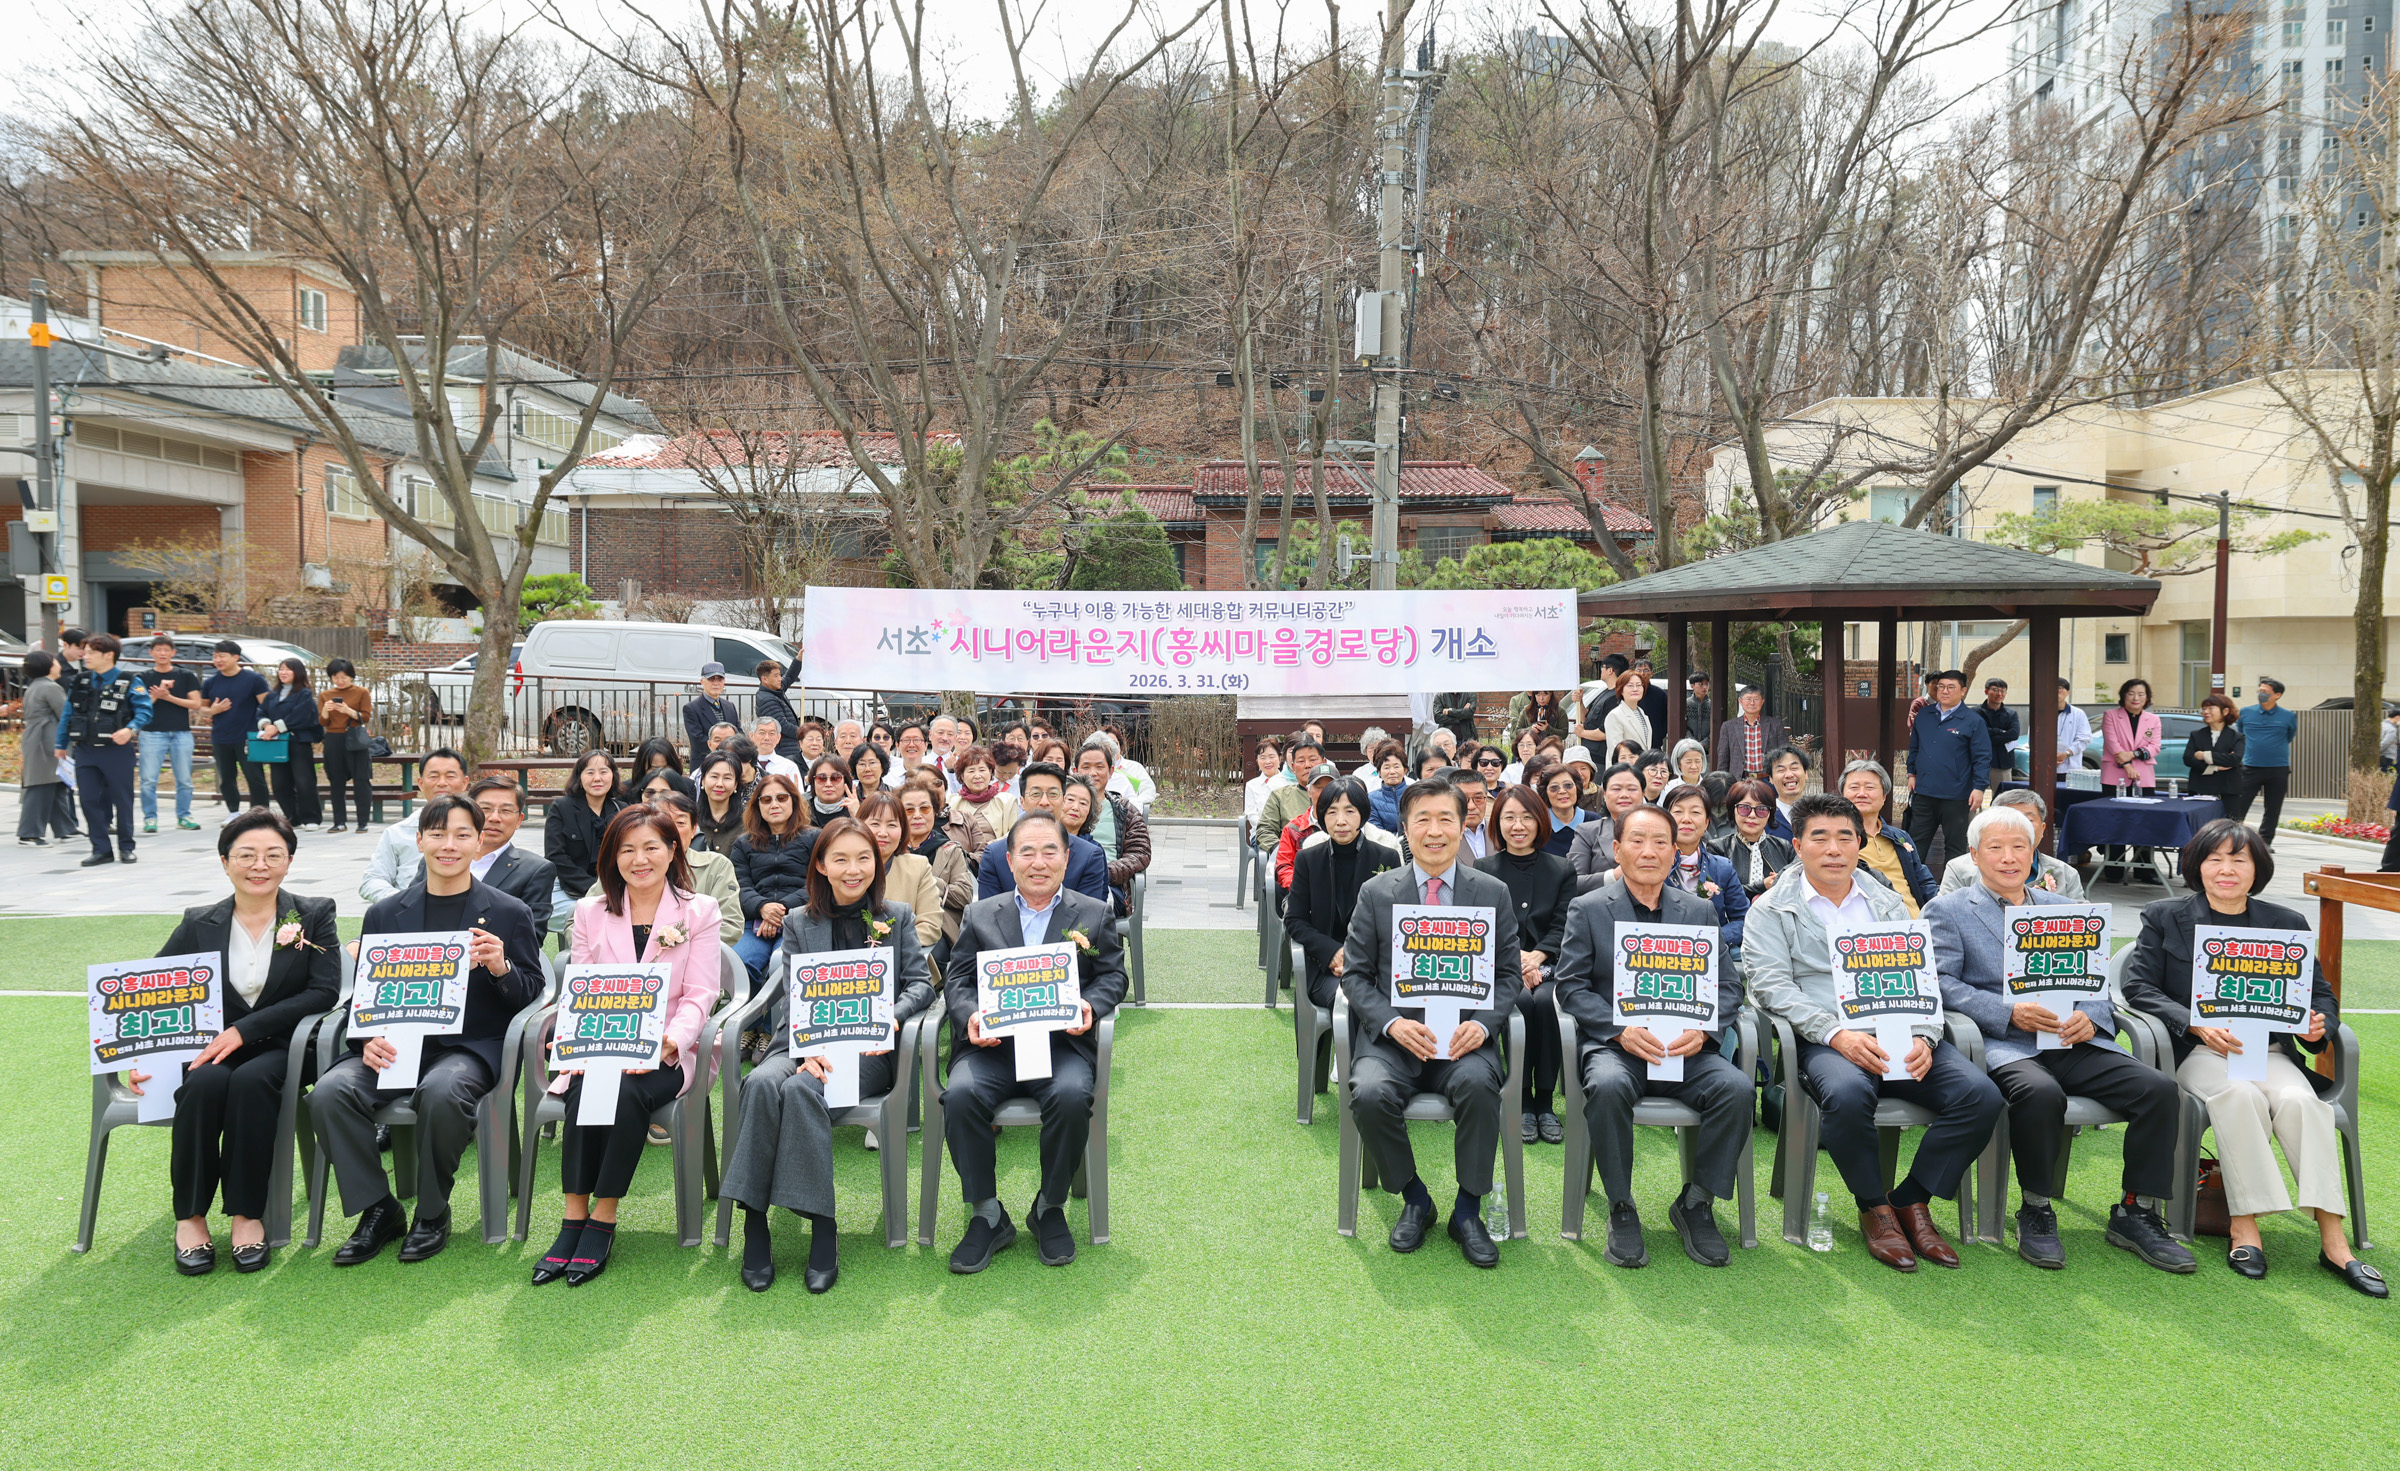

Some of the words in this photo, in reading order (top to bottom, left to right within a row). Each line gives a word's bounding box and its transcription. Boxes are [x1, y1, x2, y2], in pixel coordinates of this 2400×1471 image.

[1023, 602, 1080, 618] “누구나
[1085, 602, 1116, 620] 이용
[1122, 602, 1171, 620] 가능한
[1176, 602, 1242, 620] 세대융합
[1249, 602, 1353, 619] 커뮤니티공간”
[1535, 605, 1559, 619] 서초
[877, 625, 931, 655] 서초
[950, 626, 1417, 666] 시니어라운지(홍씨마을경로당)
[1431, 627, 1496, 660] 개소
[1130, 674, 1172, 688] 2026.
[1178, 674, 1191, 688] 3.
[1197, 674, 1249, 691] 31.(화)
[1419, 921, 1469, 936] 홍씨마을
[2032, 919, 2084, 933] 홍씨마을
[1407, 936, 1481, 952] 시니어라운지
[1642, 938, 1692, 954] 홍씨마을
[1856, 936, 1906, 951] 홍씨마을
[2020, 934, 2096, 948] 시니어라운지
[388, 947, 443, 962] 홍씨마을
[2226, 942, 2284, 958] 홍씨마을
[1004, 957, 1052, 972] 홍씨마을
[1416, 955, 1468, 980] 최고!
[1629, 955, 1704, 971] 시니어라운지
[1847, 952, 1921, 969] 시니어라운지
[2029, 952, 2084, 975] 최고!
[2211, 958, 2297, 976] 시니어라운지
[372, 962, 454, 978] 시니어라운지
[817, 964, 867, 980] 홍씨마을
[992, 968, 1065, 987] 시니어라운지
[123, 971, 188, 991] 홍씨마을
[590, 979, 642, 993] 홍씨마을
[805, 979, 880, 998] 시니어라운지
[1638, 973, 1692, 1000] 최고!
[1860, 972, 1914, 997] 최고!
[2014, 981, 2037, 990] 10번째
[2038, 978, 2052, 986] 서초
[2055, 978, 2100, 987] 시니어라운지
[379, 981, 439, 1006] 최고!
[1002, 985, 1055, 1008] 최고!
[1401, 983, 1423, 992] 10번째
[1441, 983, 1486, 996] 시니어라운지
[2220, 976, 2282, 1003] 최고!
[108, 986, 205, 1010] 시니어라운지
[574, 995, 652, 1009] 시니어라운지
[814, 999, 868, 1025] 최고!
[1648, 1002, 1662, 1010] 서초
[1664, 1002, 1709, 1016] 시니어라운지
[1848, 1004, 1870, 1014] 10번째
[1872, 1001, 1887, 1009] 서초
[1889, 1000, 1933, 1010] 시니어라운지
[2203, 1005, 2228, 1013] 10번째
[2230, 1004, 2246, 1012] 서초
[2249, 1005, 2300, 1020] 시니어라운지
[122, 1007, 190, 1037] 최고!
[360, 1013, 385, 1023] 10번째
[387, 1010, 403, 1019] 서초
[405, 1009, 454, 1019] 시니어라운지
[988, 1016, 1011, 1025] 10번째
[1013, 1012, 1027, 1020] 서초
[1029, 1008, 1073, 1017] 시니어라운지
[579, 1014, 638, 1039] 최고!
[799, 1032, 822, 1043] 10번째
[823, 1029, 838, 1038] 서초
[840, 1027, 885, 1036] 시니어라운지
[101, 1045, 133, 1058] 10번째
[135, 1040, 154, 1050] 서초
[561, 1045, 585, 1055] 10번째
[587, 1044, 602, 1052] 서초
[605, 1043, 652, 1054] 시니어라운지
